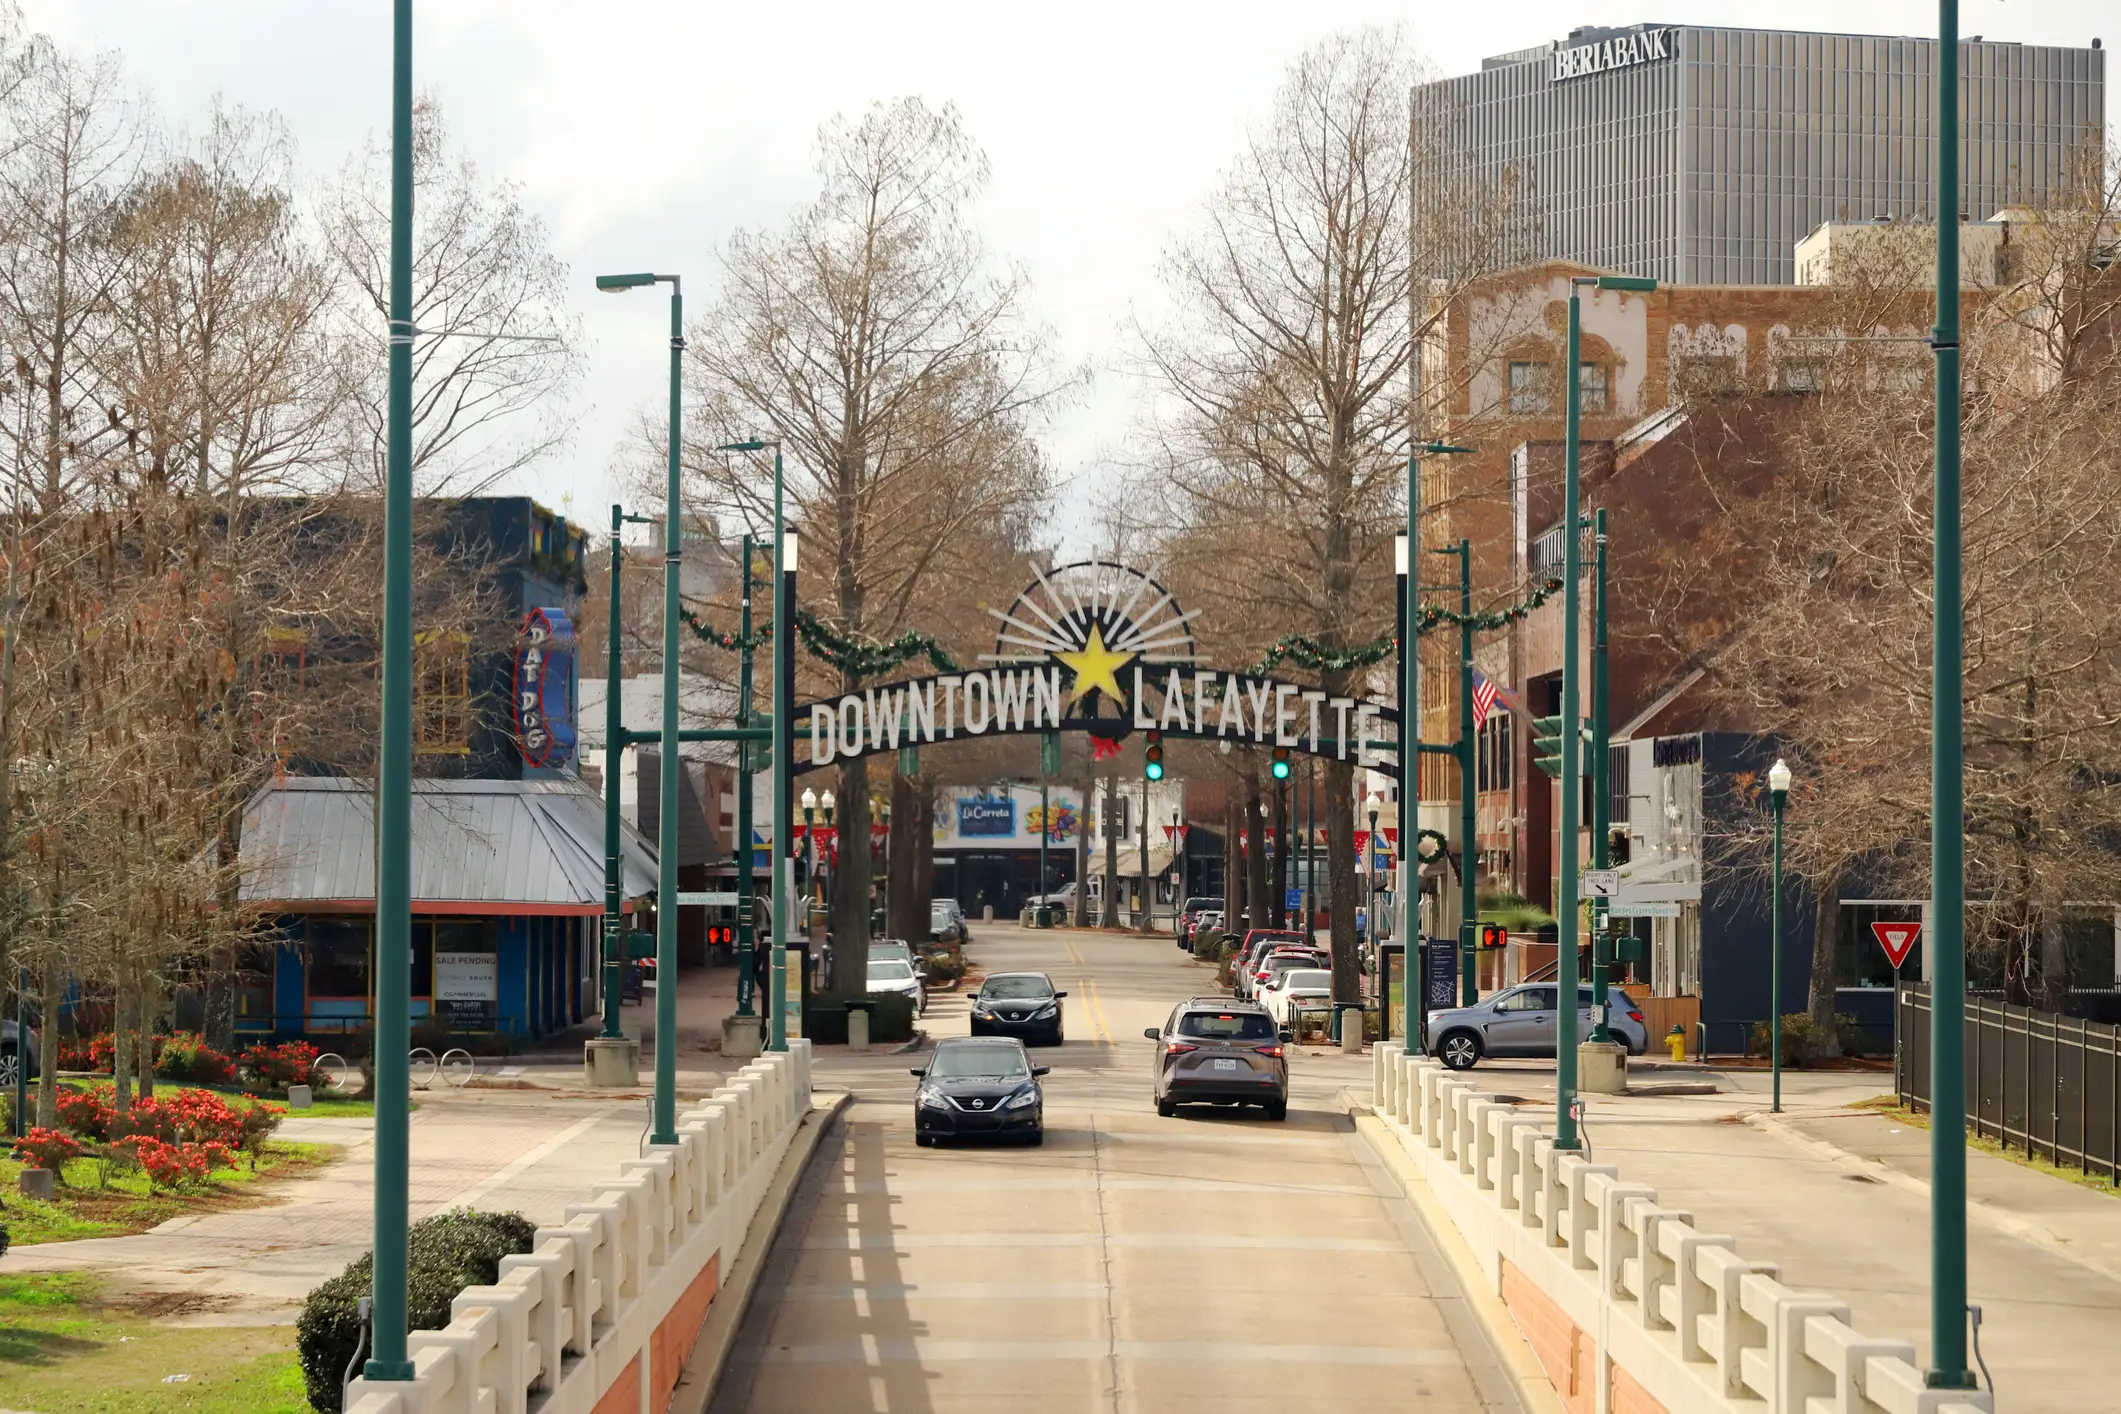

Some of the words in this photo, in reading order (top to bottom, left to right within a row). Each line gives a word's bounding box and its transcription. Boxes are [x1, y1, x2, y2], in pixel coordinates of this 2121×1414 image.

[523, 626, 545, 683] DAT
[521, 691, 547, 749] DOG
[811, 666, 1060, 766] DOWNTOWN
[1133, 666, 1381, 767] LAFAYETTE
[973, 806, 1010, 819] Carreta
[1498, 930, 1506, 945] 0
[1889, 933, 1905, 941] YIELD
[436, 956, 457, 965] SALE
[459, 956, 496, 965] PENDING
